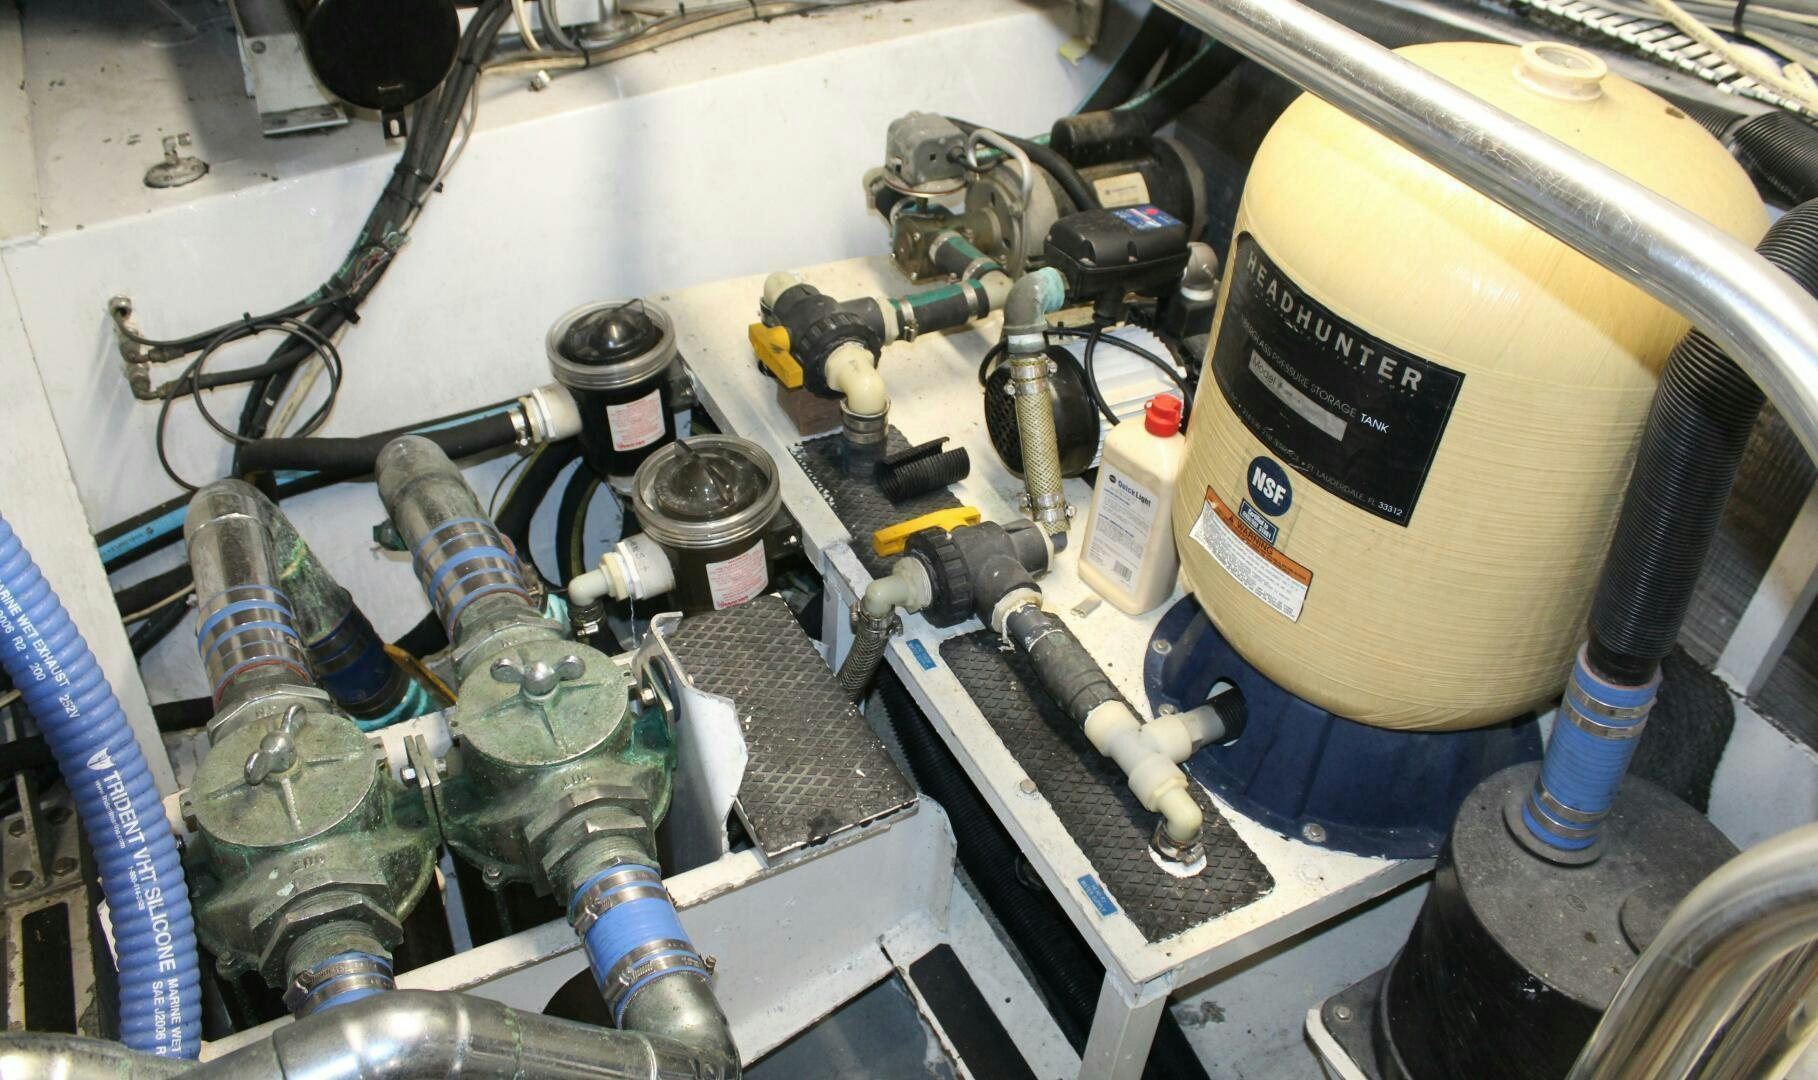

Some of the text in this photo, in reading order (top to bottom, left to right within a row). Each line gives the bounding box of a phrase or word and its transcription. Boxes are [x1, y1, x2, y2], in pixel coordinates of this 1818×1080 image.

[1246, 250, 1424, 393] HEADHUNTER
[1252, 356, 1277, 385] Model
[1272, 352, 1310, 388] PRESSURE
[1310, 383, 1358, 418] STORAGE
[1360, 412, 1390, 434] TANK
[1252, 466, 1287, 506] NSF
[1377, 501, 1403, 516] 33312
[1237, 521, 1273, 556] WARNING
[0, 609, 15, 634] 2006
[12, 636, 27, 652] R2
[29, 662, 46, 681] 200
[0, 581, 81, 719] ARINE WET EXHAUST 252V
[104, 770, 176, 973] TRIDENT VHT SILICONE
[152, 981, 164, 1005] SAE
[167, 978, 182, 1053] MARINE WET
[154, 1008, 167, 1041] J2006
